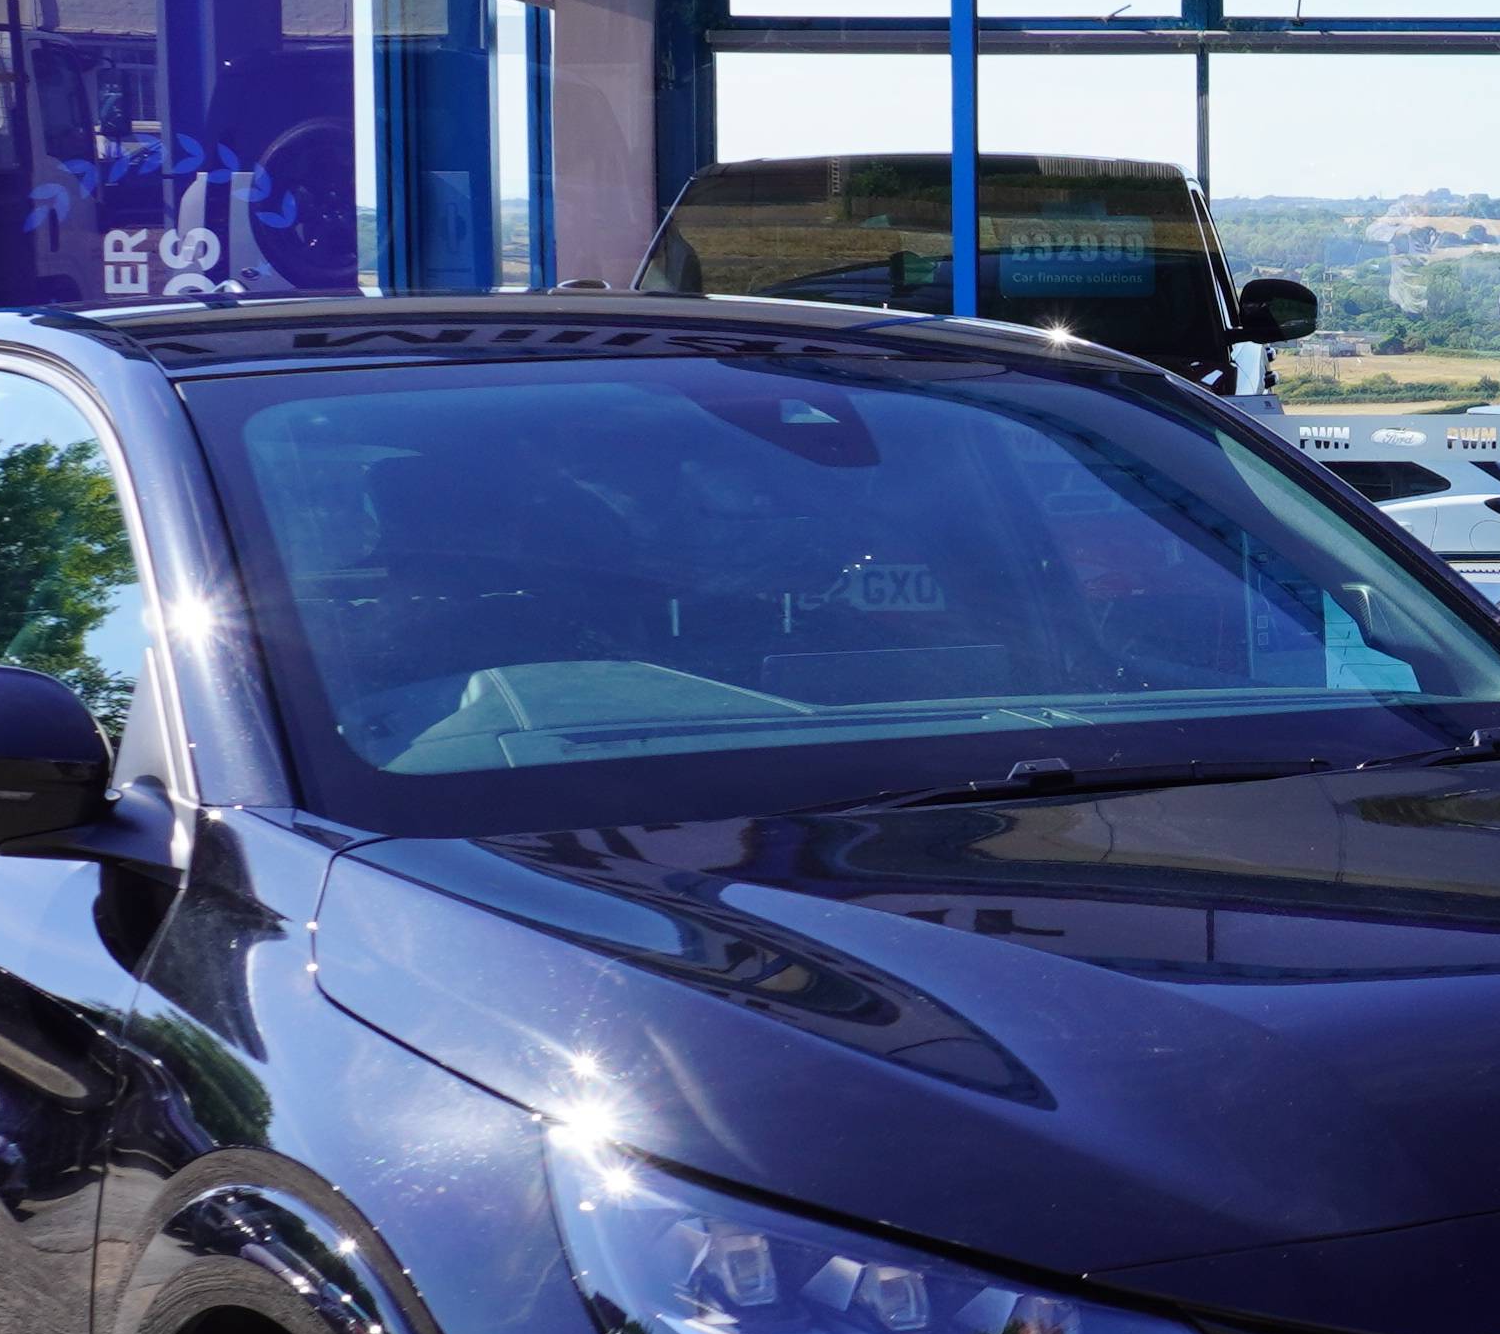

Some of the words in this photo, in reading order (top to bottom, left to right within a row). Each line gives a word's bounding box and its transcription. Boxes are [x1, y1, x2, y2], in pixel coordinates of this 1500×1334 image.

[1012, 272, 1035, 284] Car
[1038, 272, 1083, 284] finance
[1086, 272, 1143, 284] solutions
[1299, 426, 1350, 449] PWM
[1447, 427, 1497, 449] PWM
